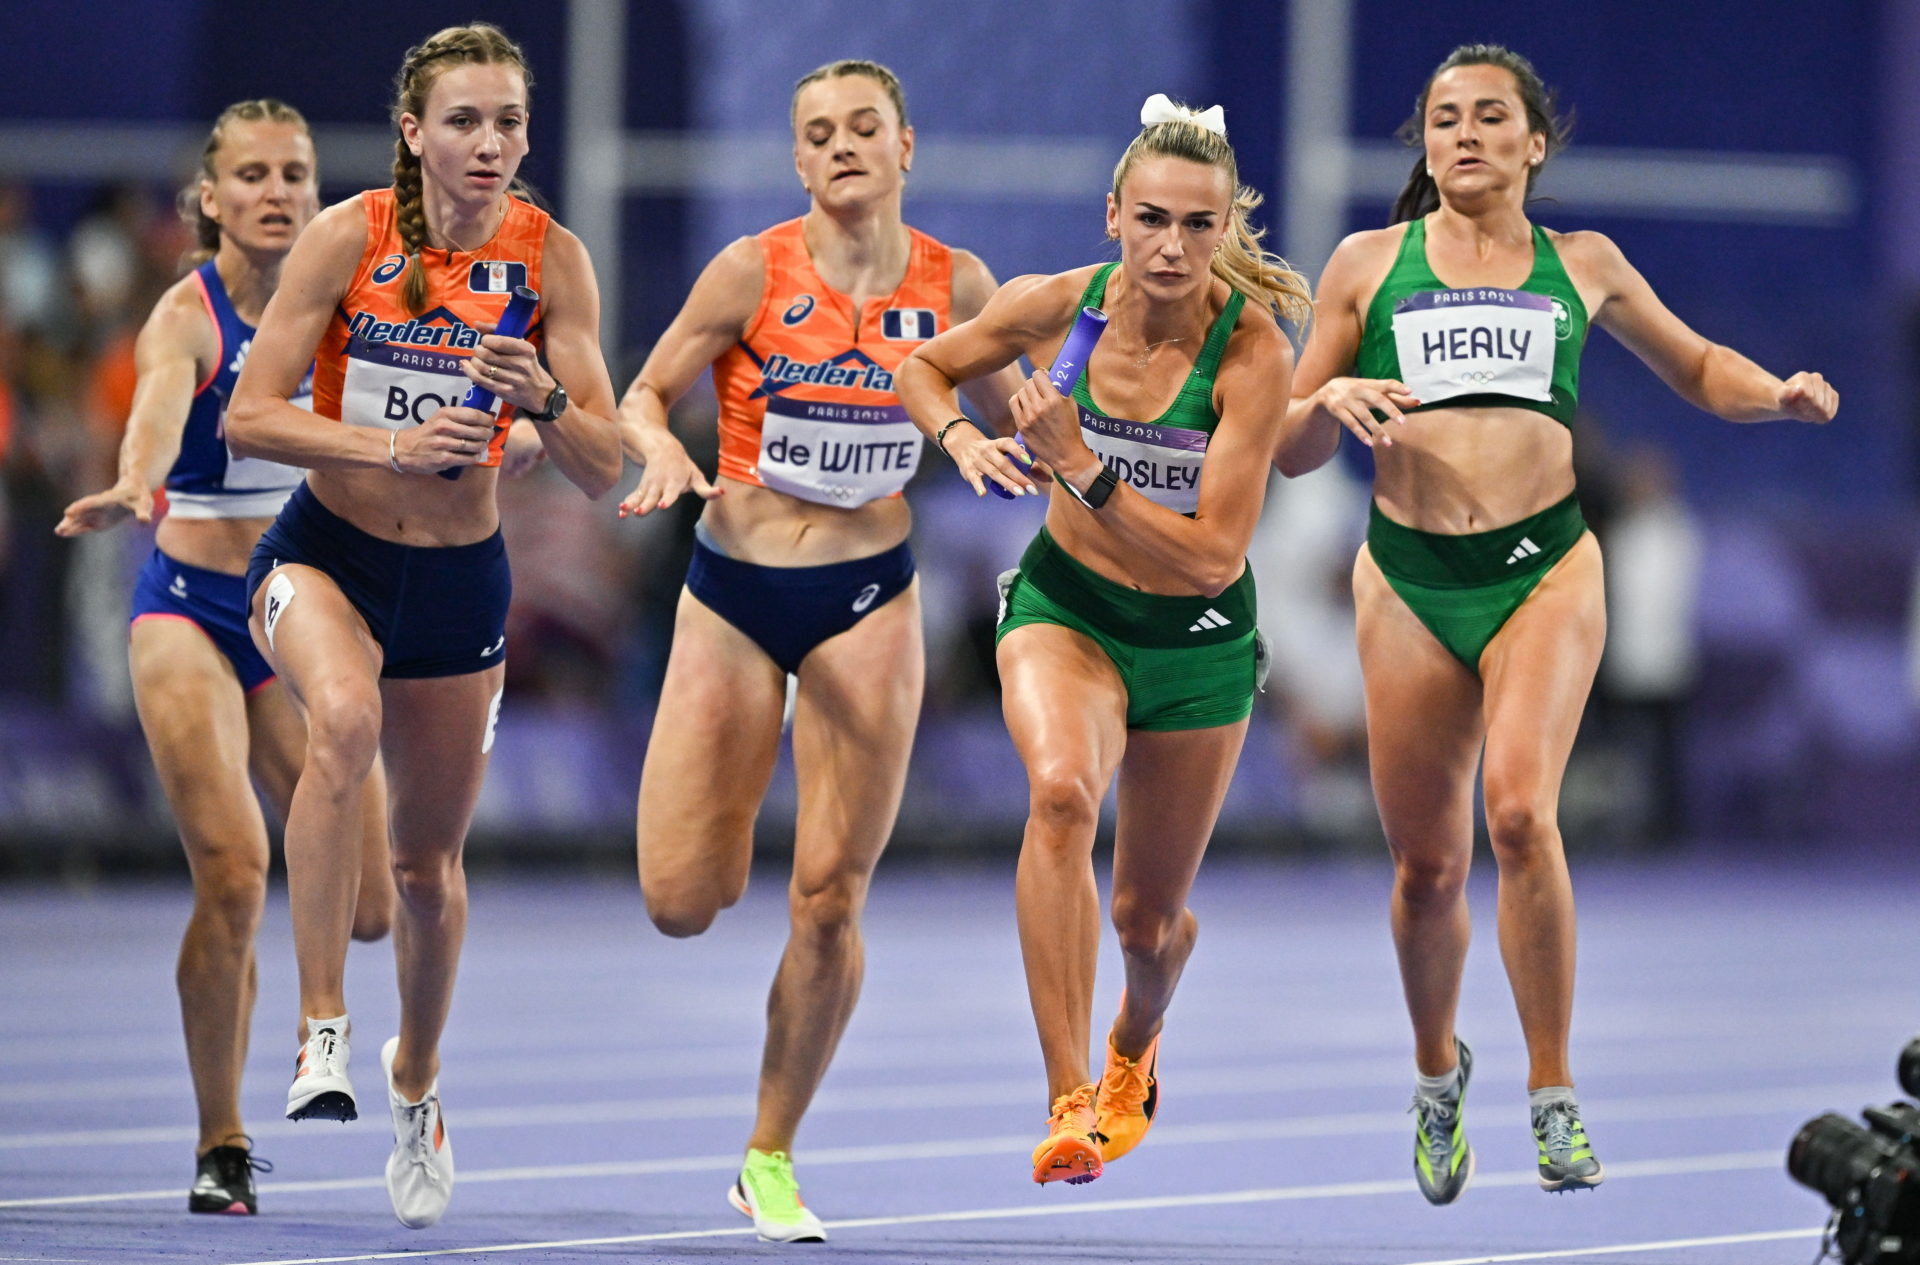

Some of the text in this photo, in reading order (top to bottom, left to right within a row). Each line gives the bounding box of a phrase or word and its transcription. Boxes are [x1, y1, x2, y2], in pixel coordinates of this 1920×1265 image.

[1433, 290, 1514, 304] PARIS 2024
[348, 311, 480, 349] Nederla
[1422, 326, 1532, 365] HEALY
[392, 352, 465, 371] PARIS 20
[762, 354, 895, 393] Nederla
[808, 405, 889, 421] PARIS 2024
[1084, 413, 1162, 441] PARIS 2024
[767, 435, 915, 474] de WITTE
[1089, 448, 1200, 490] UDSLEY
